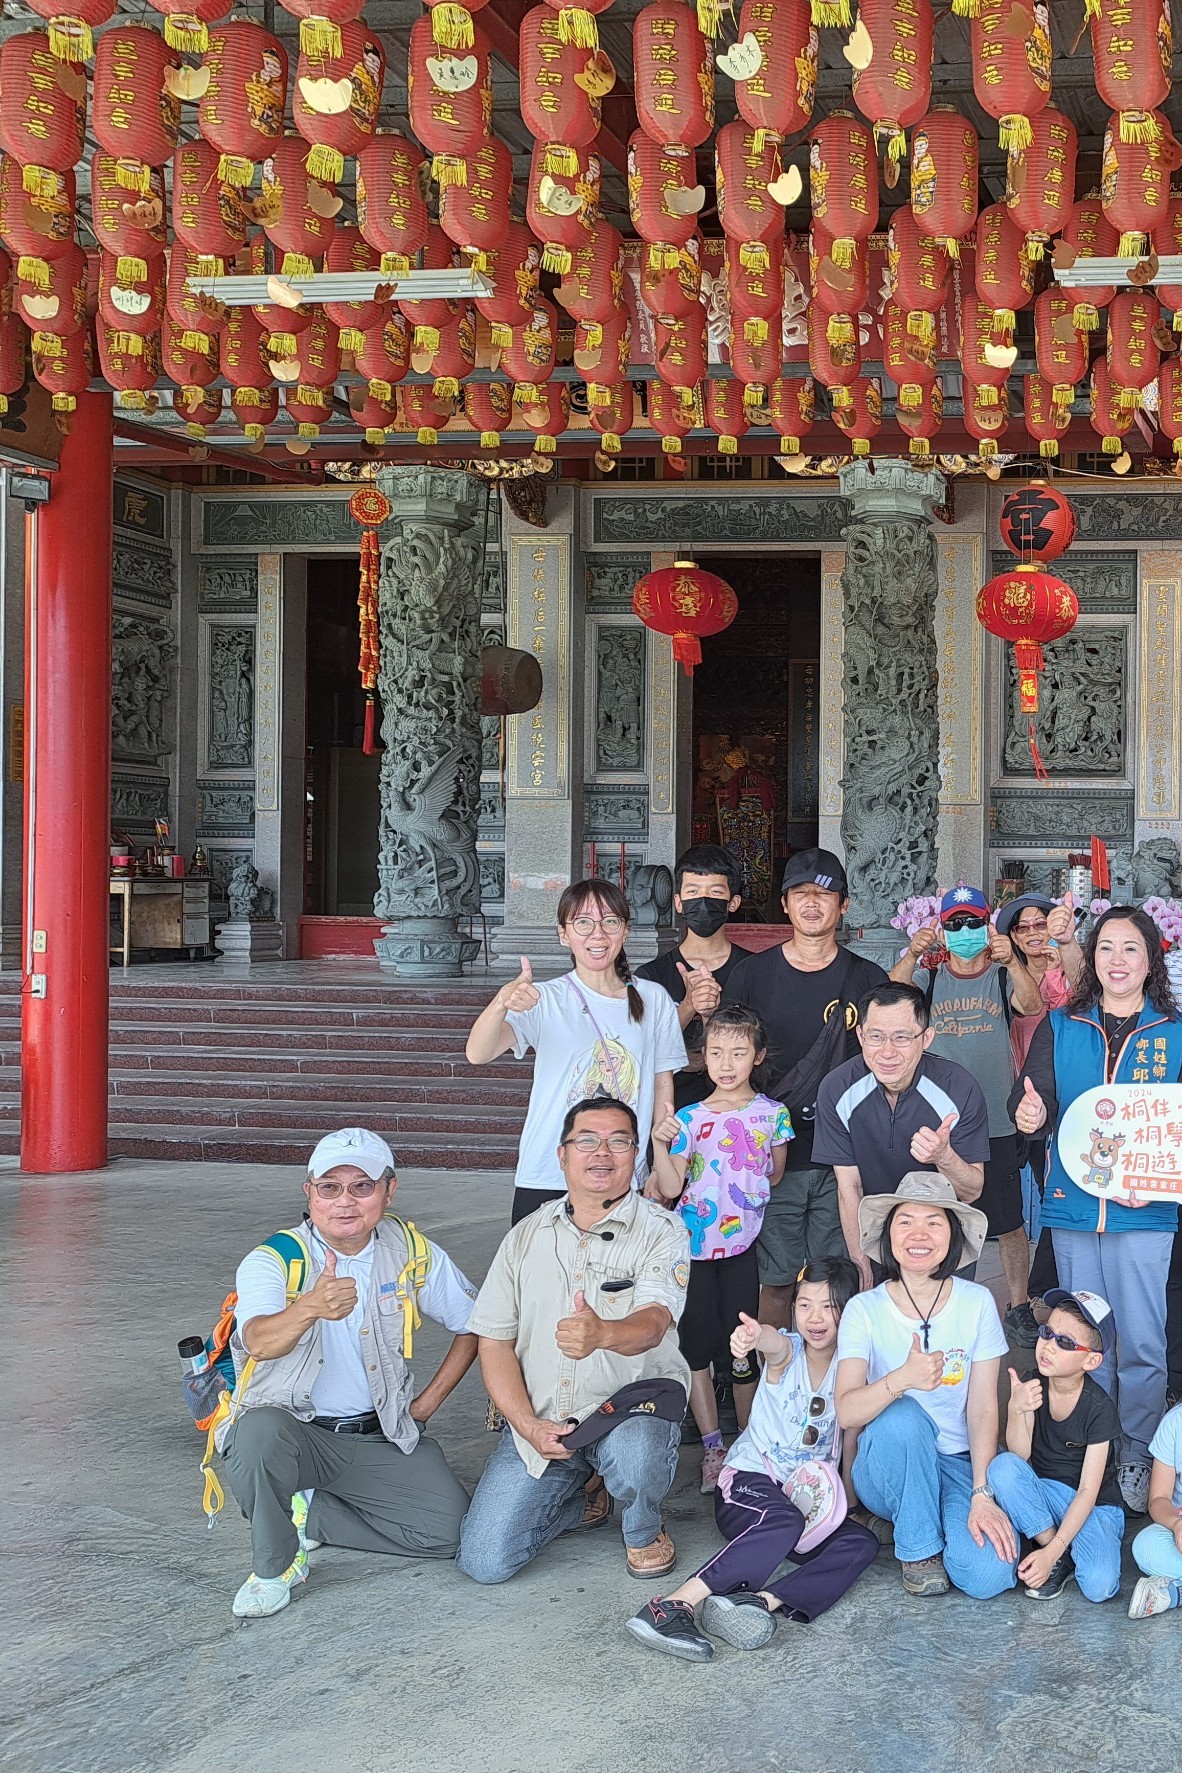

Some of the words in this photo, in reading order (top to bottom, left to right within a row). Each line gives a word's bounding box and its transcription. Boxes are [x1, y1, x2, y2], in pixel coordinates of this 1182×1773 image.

[1001, 489, 1060, 552] 宮
[934, 1021, 994, 1037] California
[1128, 1089, 1152, 1098] 2024
